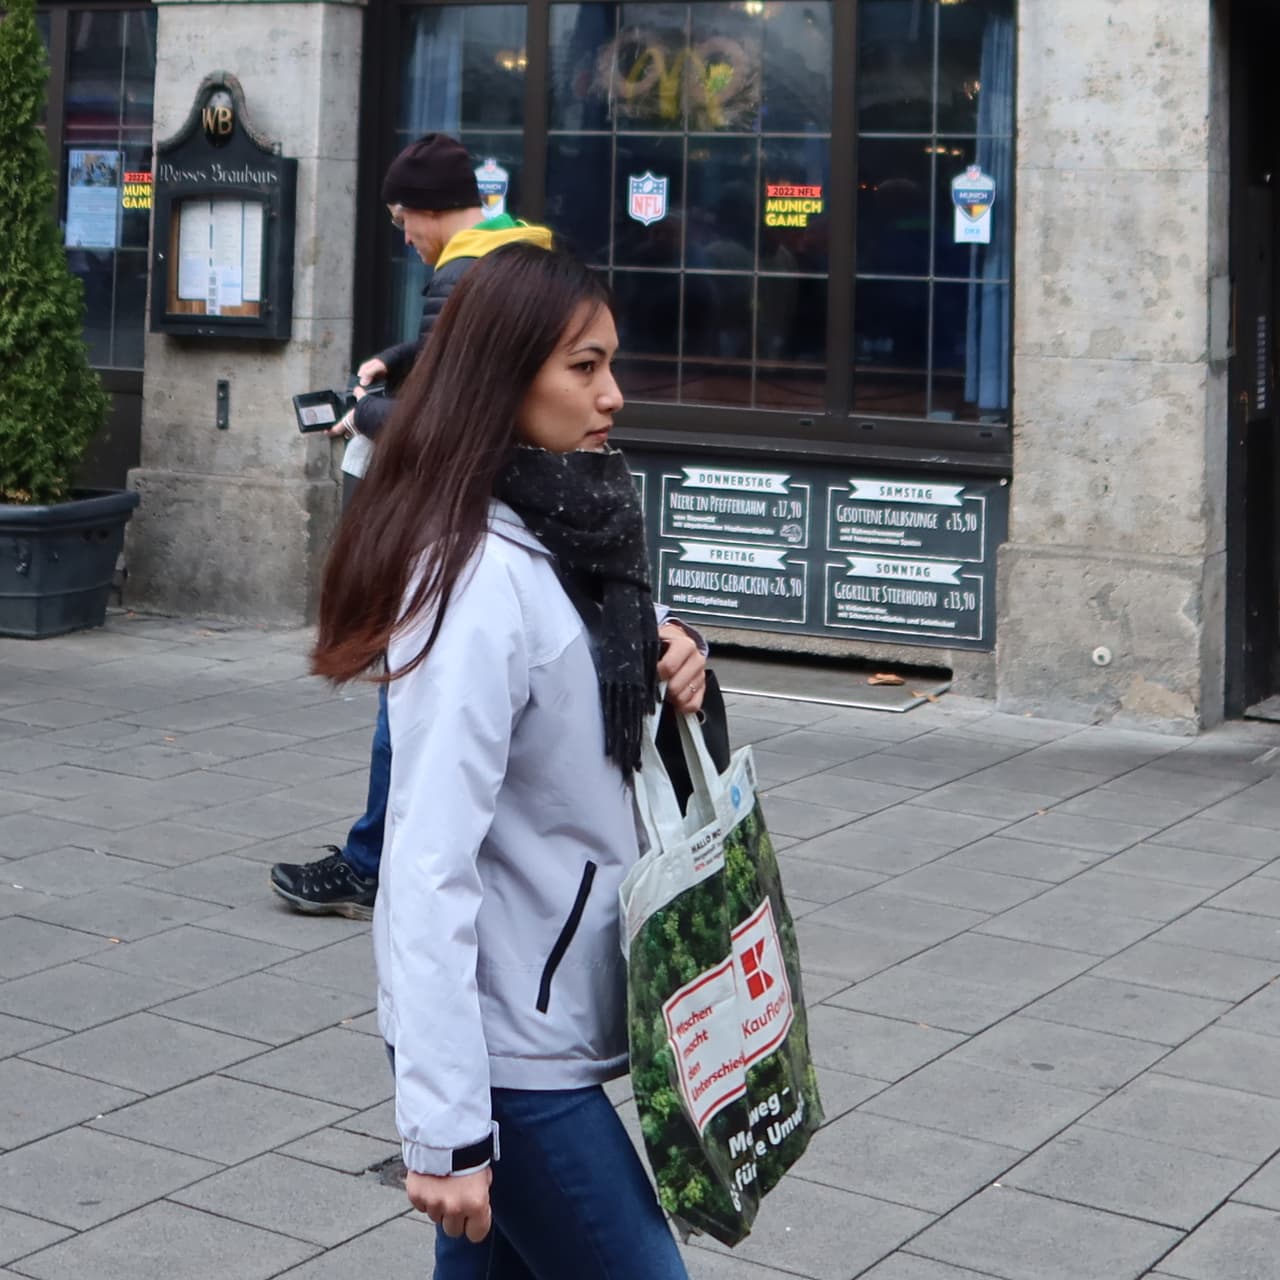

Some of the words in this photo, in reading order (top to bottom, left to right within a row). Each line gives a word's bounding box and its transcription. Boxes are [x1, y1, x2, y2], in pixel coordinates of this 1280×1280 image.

[202, 106, 233, 135] WB
[773, 187, 795, 196] 2022
[798, 188, 816, 196] NFL
[634, 195, 662, 217] NFL
[766, 200, 822, 213] MUNICH
[766, 213, 807, 227] GAME
[698, 473, 773, 488] DONNERSTAG
[879, 485, 933, 500] SAMSTAG
[710, 549, 756, 563] FREITAG
[876, 563, 931, 578] SONNTAG
